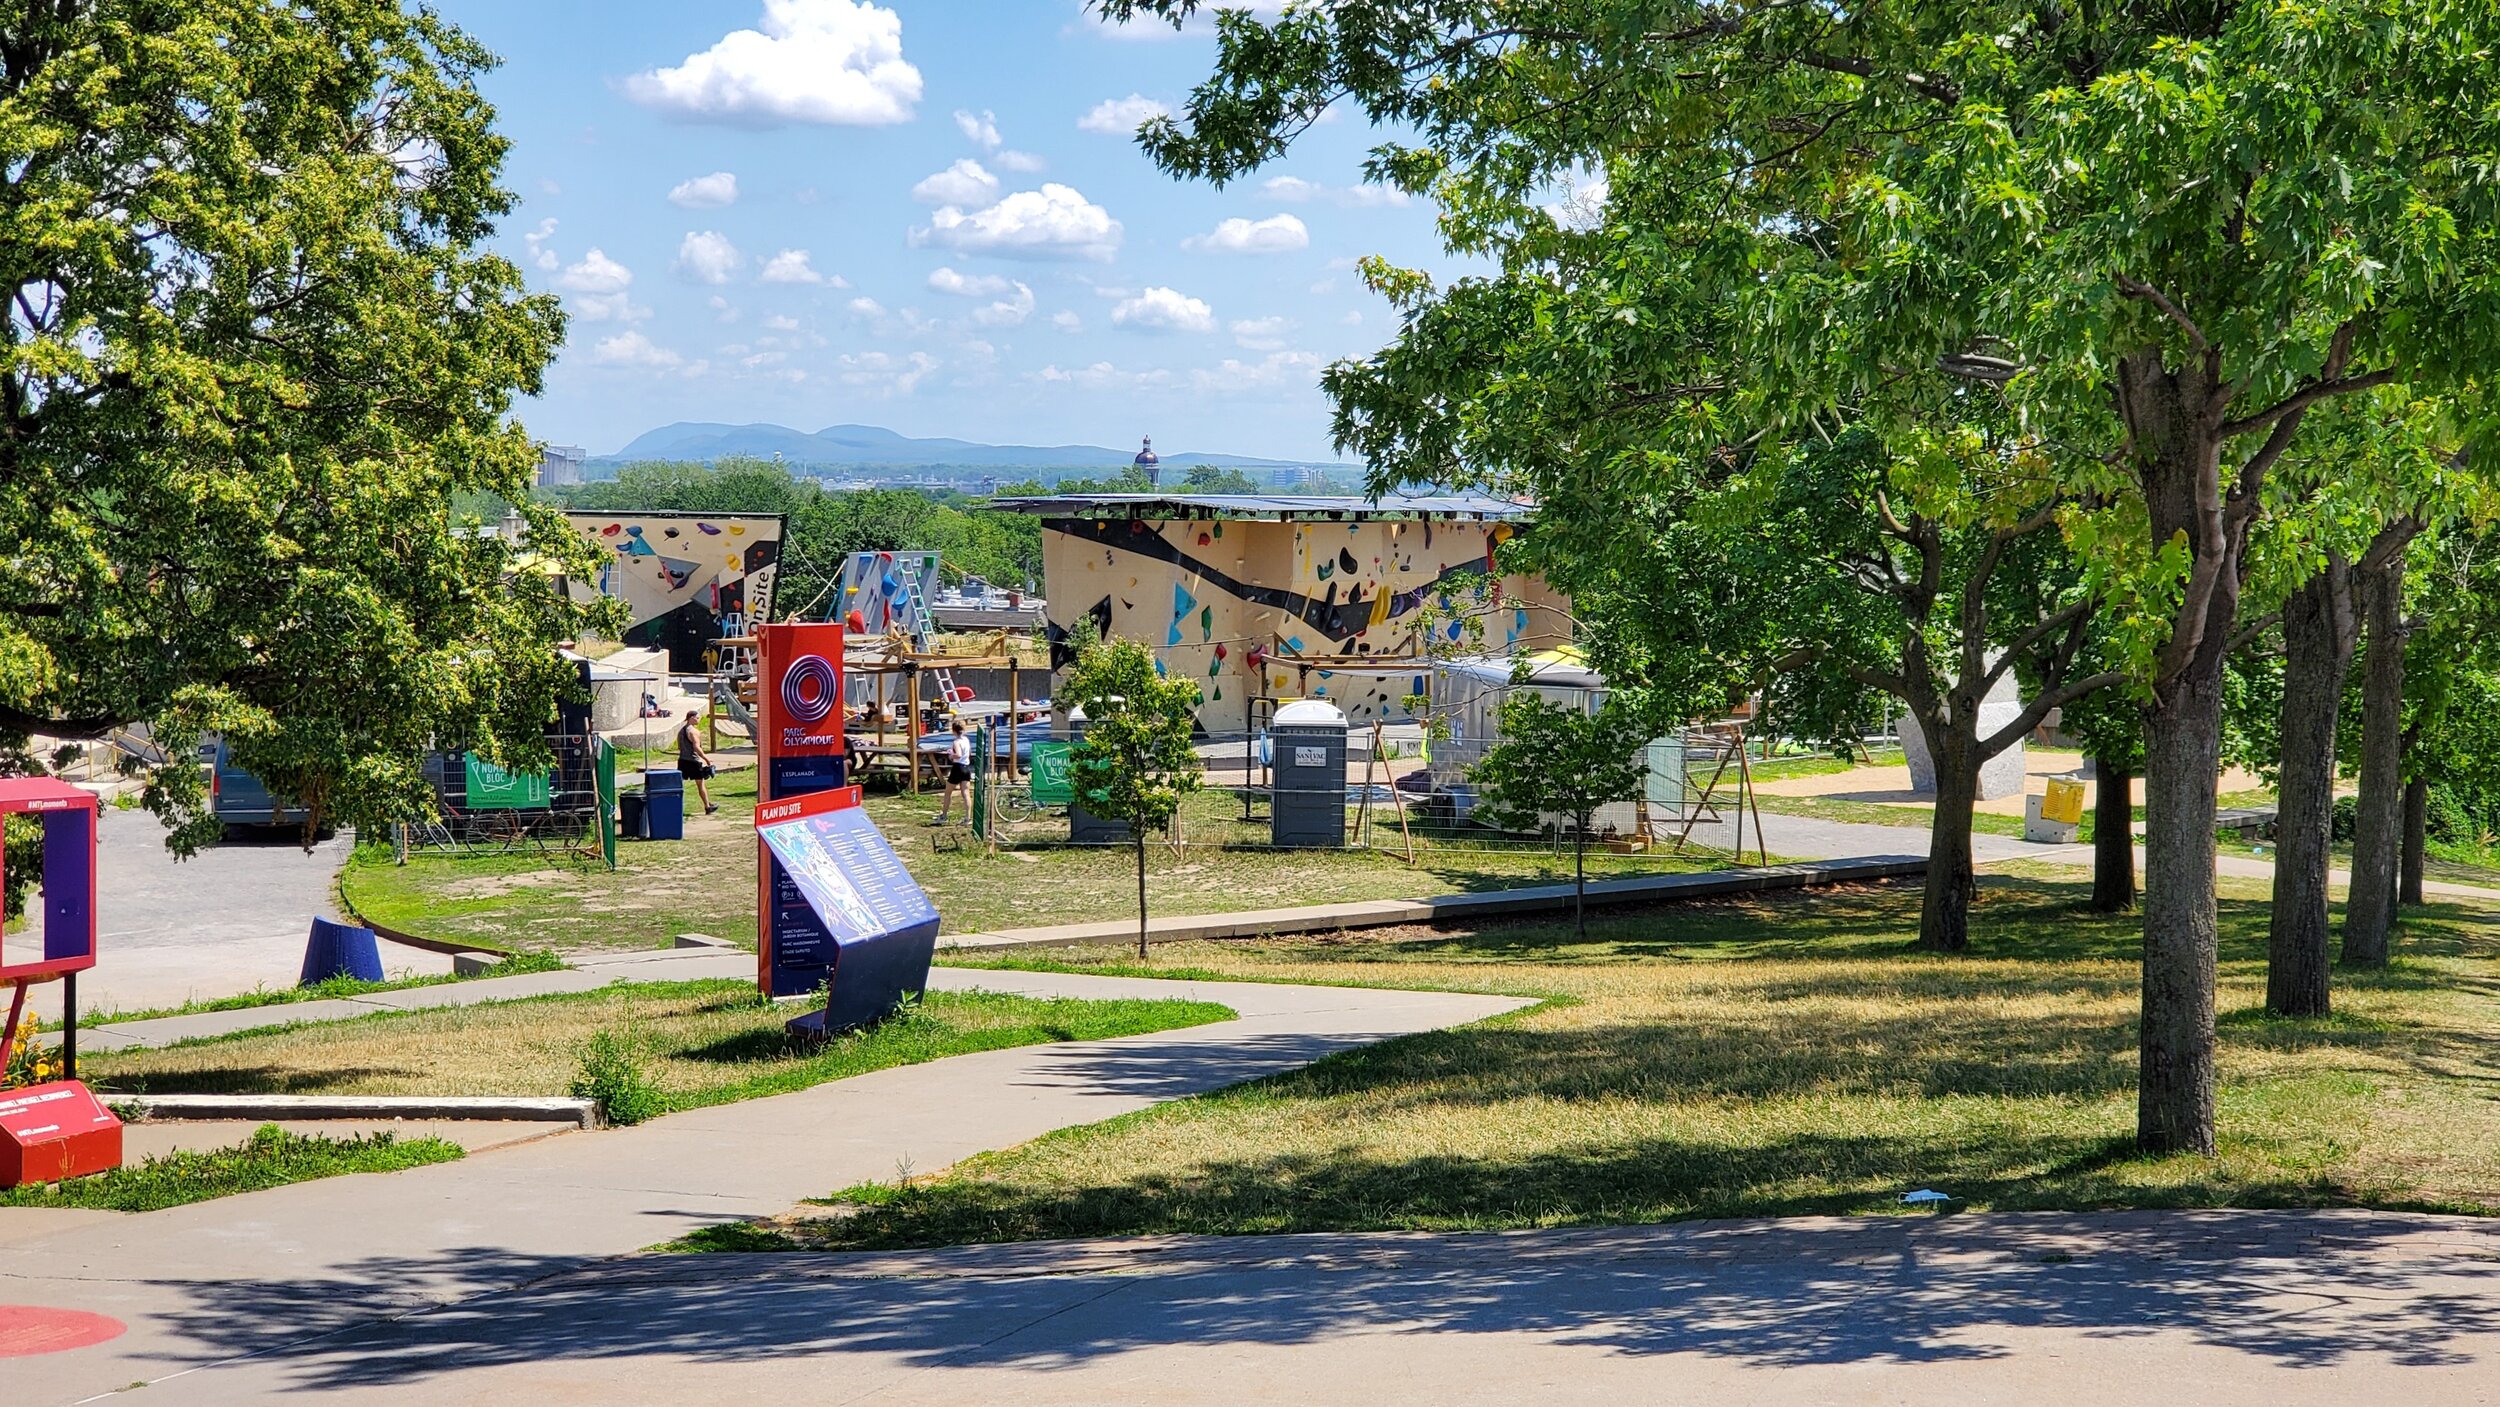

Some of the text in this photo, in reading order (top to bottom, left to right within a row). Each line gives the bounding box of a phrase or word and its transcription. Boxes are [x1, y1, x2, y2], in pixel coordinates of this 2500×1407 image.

[783, 728, 806, 736] PARC
[783, 735, 835, 746] OLYMPIQUE
[486, 773, 506, 783] BLOC
[762, 802, 802, 820] PLAN DU SITE
